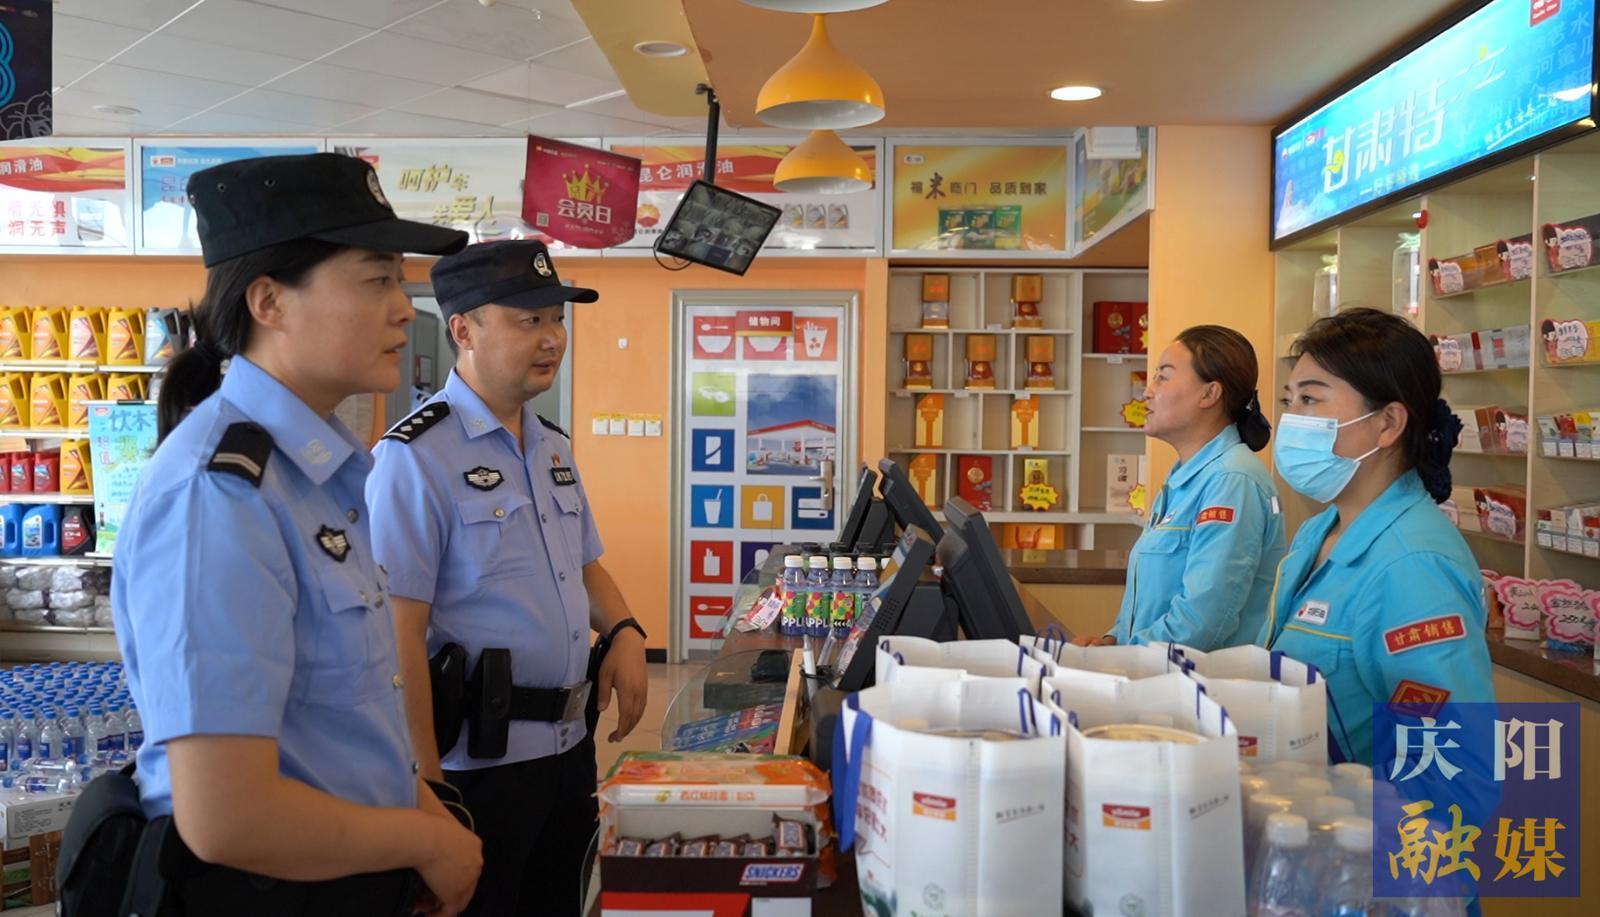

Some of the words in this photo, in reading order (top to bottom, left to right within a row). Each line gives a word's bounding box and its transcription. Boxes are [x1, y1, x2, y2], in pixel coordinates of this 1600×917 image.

[0, 158, 43, 175] 润滑油
[989, 181, 1048, 196] 品质到家
[558, 198, 611, 224] 会员日
[748, 315, 781, 327] 储物间
[1394, 620, 1456, 645] 甘肃销售
[746, 866, 801, 879] SNICKERS
